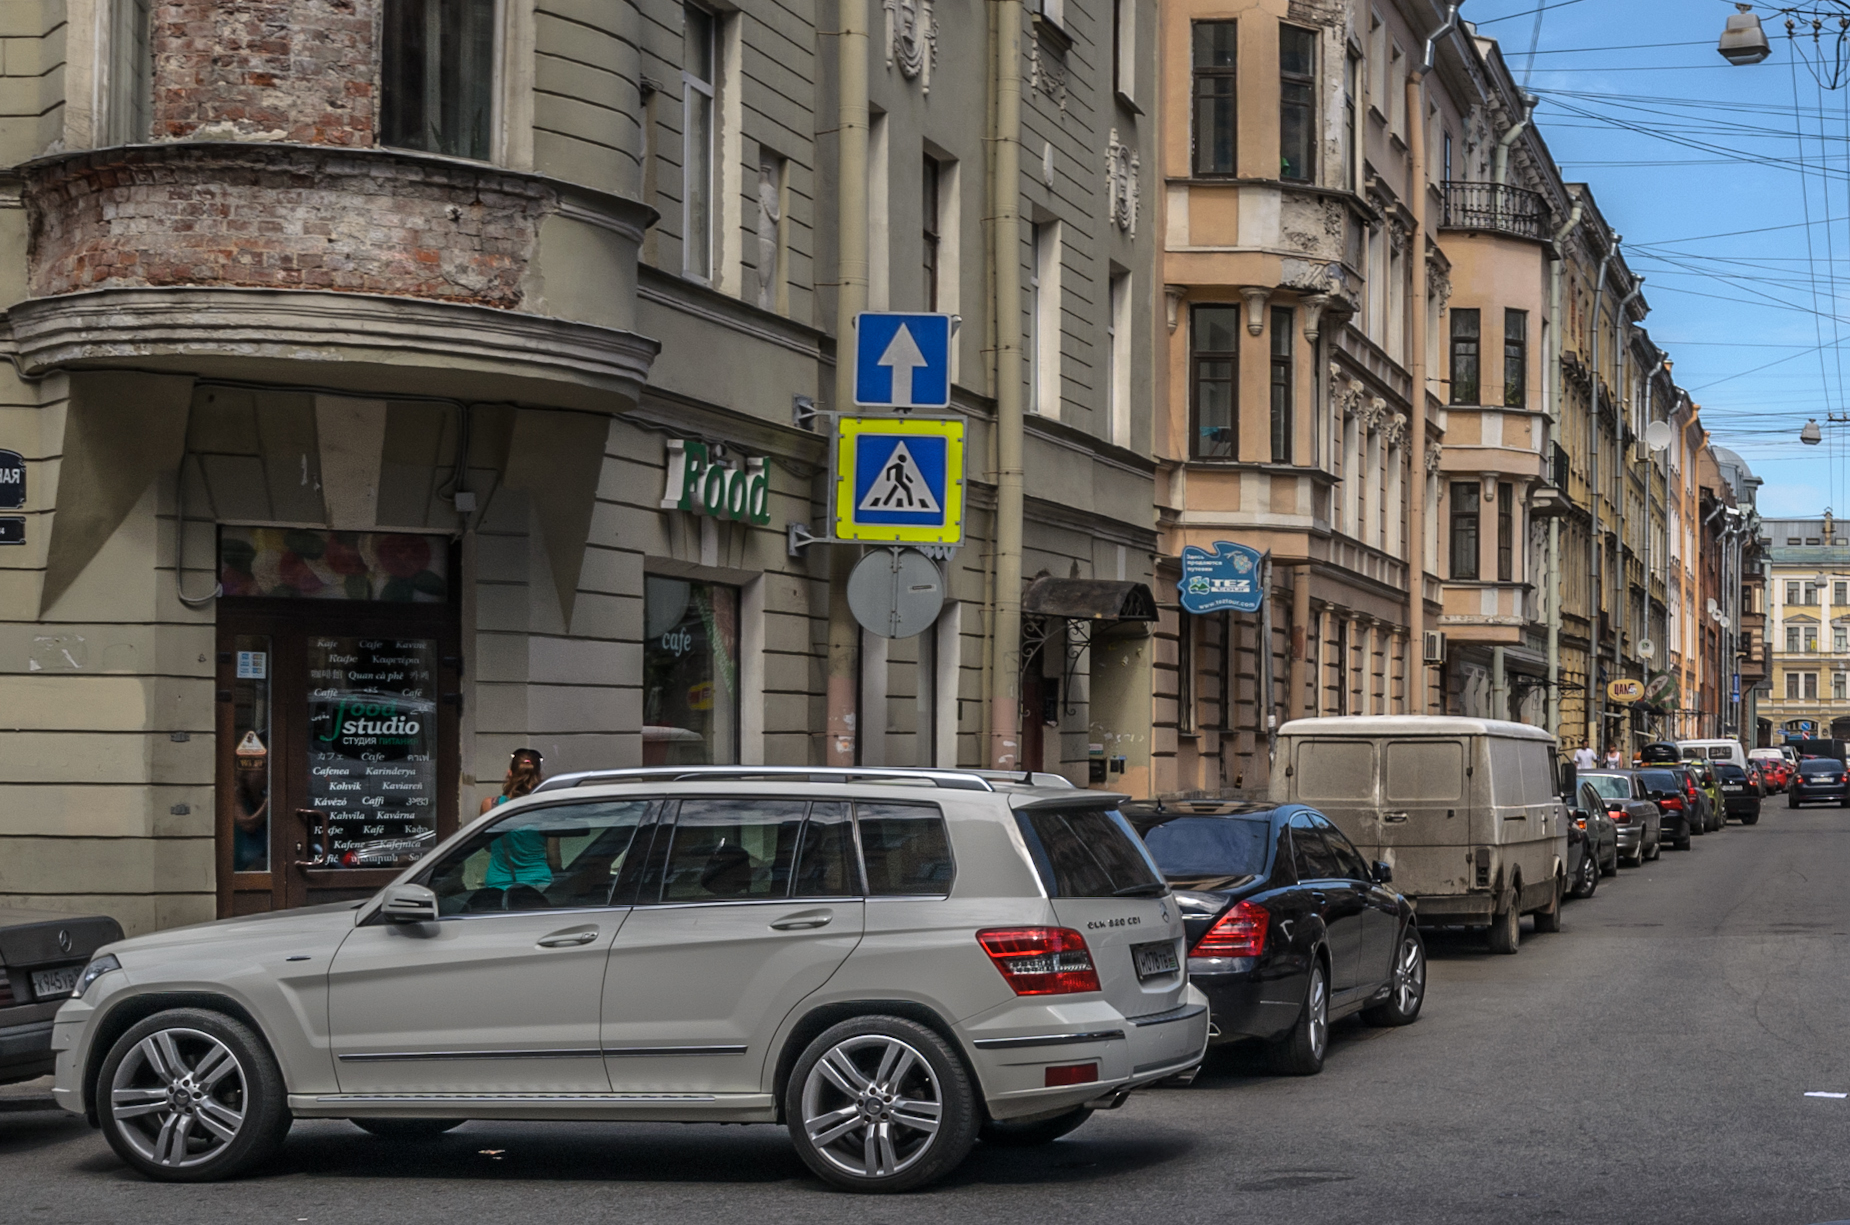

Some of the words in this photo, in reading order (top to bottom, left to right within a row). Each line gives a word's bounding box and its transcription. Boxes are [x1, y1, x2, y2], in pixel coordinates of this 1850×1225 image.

[661, 439, 771, 526] Food
[1211, 579, 1250, 587] TEZ
[661, 627, 692, 657] cafe
[319, 695, 399, 742] food
[342, 715, 420, 735] studio
[343, 736, 377, 746] СТУДИЯ
[380, 737, 419, 745] ПИТАНИЯ
[312, 767, 350, 777] Cafenea
[365, 767, 416, 777] Karinderya
[329, 781, 361, 790] Kohvik
[329, 811, 365, 820] Kahvila
[376, 810, 415, 820] Kavárna
[314, 826, 344, 836] Кфе
